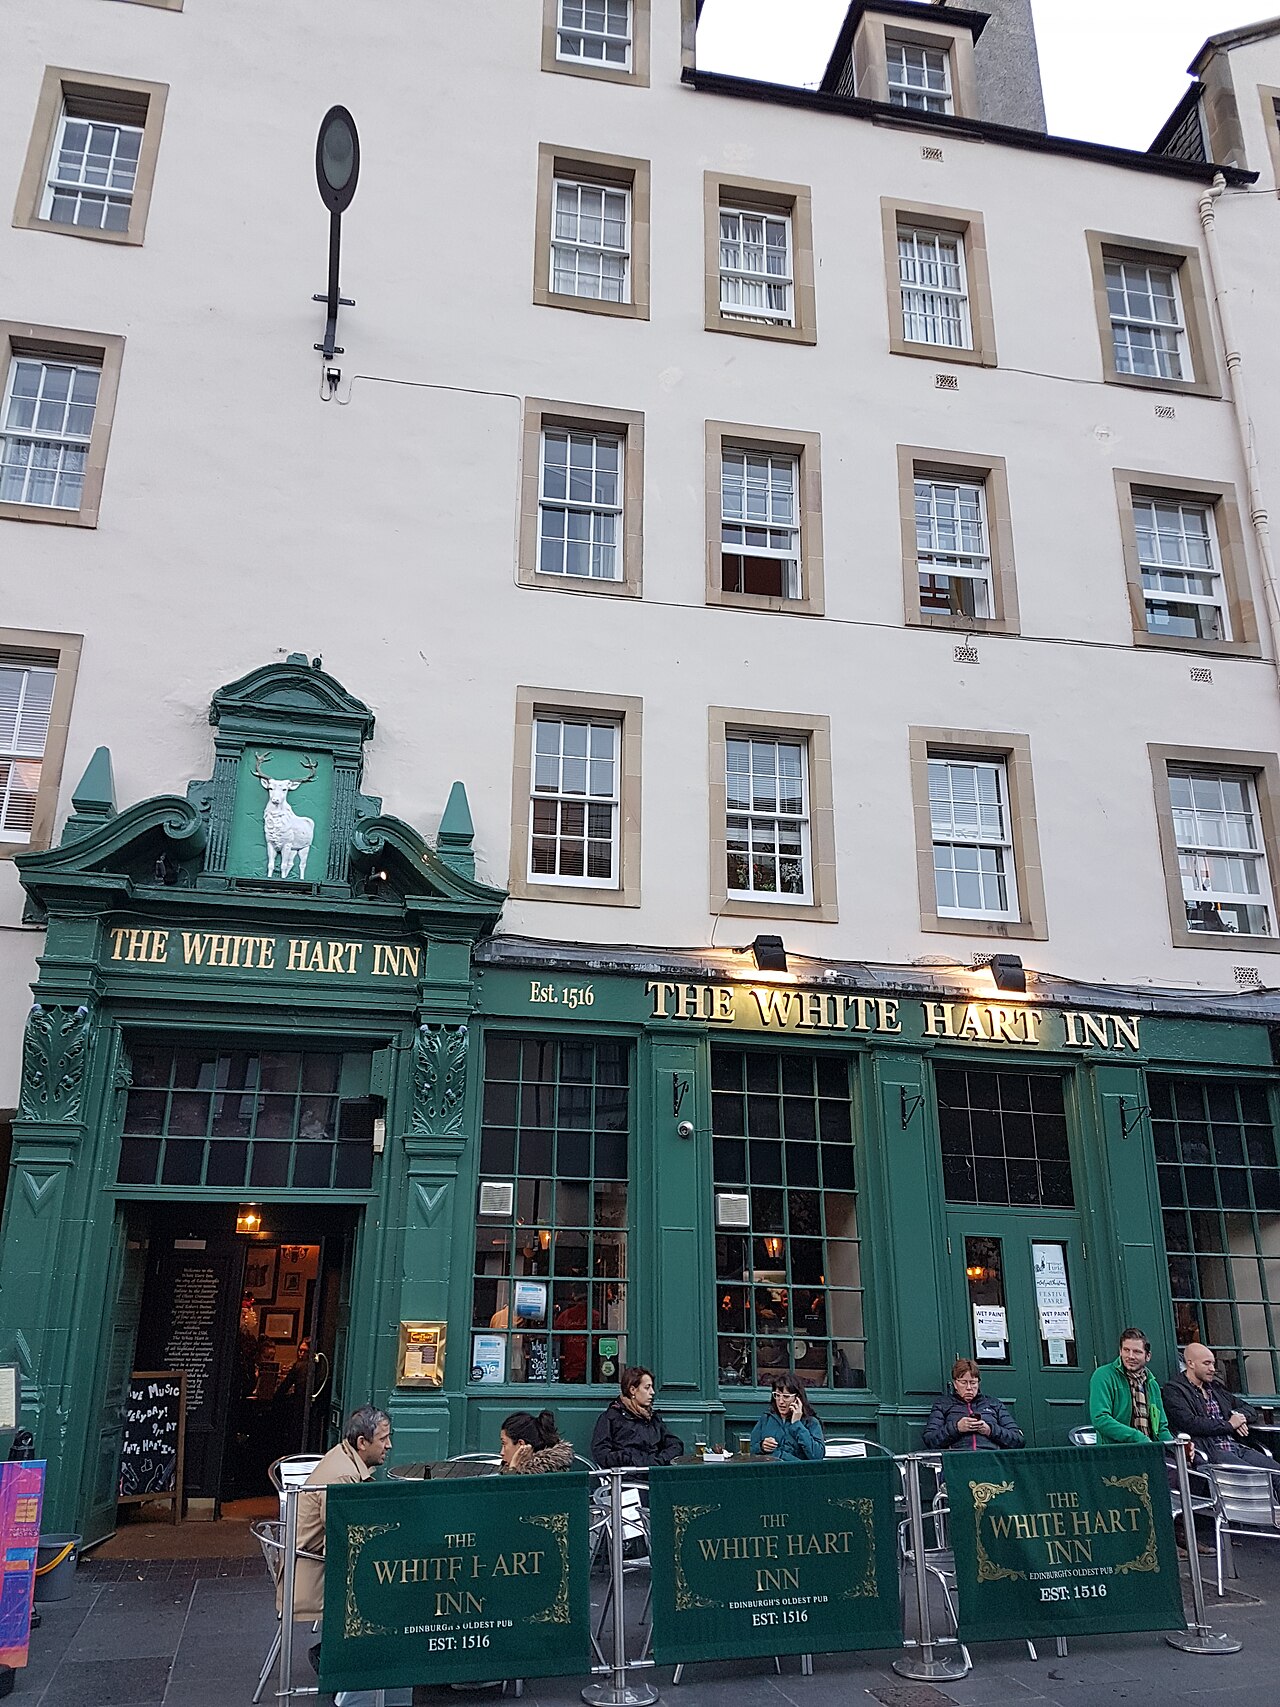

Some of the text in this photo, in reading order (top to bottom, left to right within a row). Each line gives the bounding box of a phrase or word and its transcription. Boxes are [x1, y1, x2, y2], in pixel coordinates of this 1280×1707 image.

[109, 927, 421, 978] THE WHITE HART INN
[529, 981, 595, 1008] Est. 1516
[645, 981, 1143, 1052] THE WHITE HART INN
[129, 1383, 180, 1400] IVE MUSIC
[127, 1406, 168, 1423] VERYDAY!
[1047, 1492, 1080, 1508] THE
[989, 1508, 1141, 1539] WHITE HART
[445, 1533, 476, 1549] THE
[697, 1531, 853, 1561] WHITE HART
[1046, 1539, 1093, 1565] INN
[373, 1557, 462, 1585] WHITE
[1029, 1567, 1113, 1580] EDINBURGH'S OLDEST PUB
[756, 1568, 800, 1592] INN
[1040, 1584, 1107, 1601] EST: 1516
[434, 1592, 486, 1616] INN
[729, 1599, 780, 1609] EDINBURGH'S
[782, 1597, 811, 1605] OLDEST
[752, 1610, 808, 1626] EST: 1516
[404, 1624, 460, 1634] EDINBURGHS
[462, 1621, 494, 1629] OLDEST
[428, 1635, 490, 1651] EST: 1516
